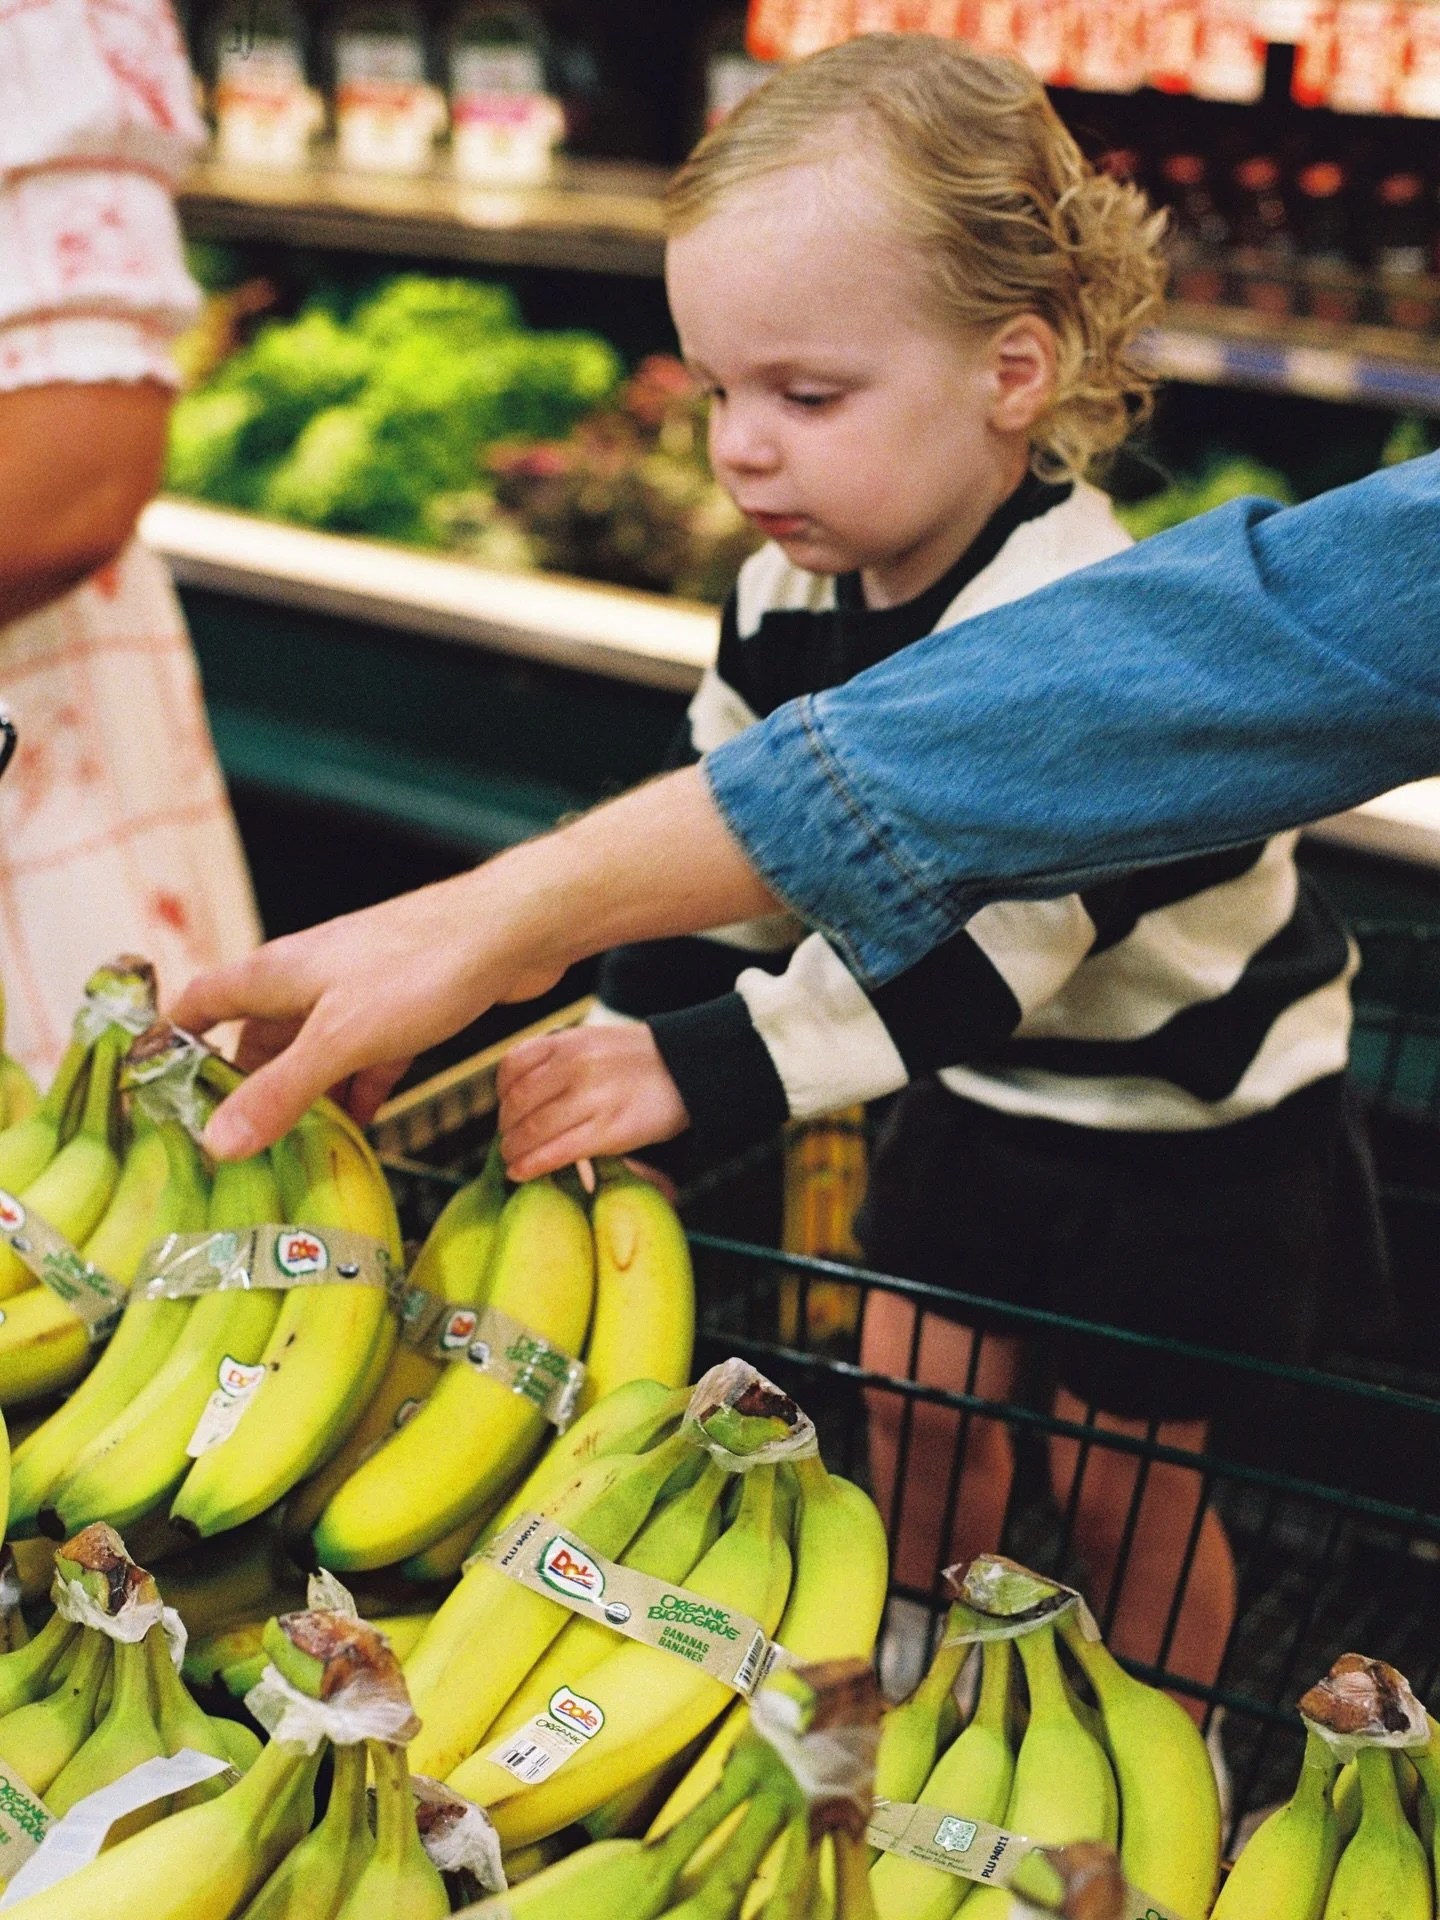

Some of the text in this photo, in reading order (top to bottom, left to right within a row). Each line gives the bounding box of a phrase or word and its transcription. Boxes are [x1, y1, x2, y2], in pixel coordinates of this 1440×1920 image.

[501, 1520, 541, 1566] PLU 94011
[648, 1606, 741, 1641] BIOLOGIQUE
[660, 1594, 731, 1625] ORGANIC
[658, 1636, 705, 1663] BANANES
[662, 1626, 711, 1654] BANANAS
[558, 1699, 598, 1728] Dole
[536, 1719, 583, 1745] ORGANIC
[981, 1835, 1010, 1878] PLU 94011
